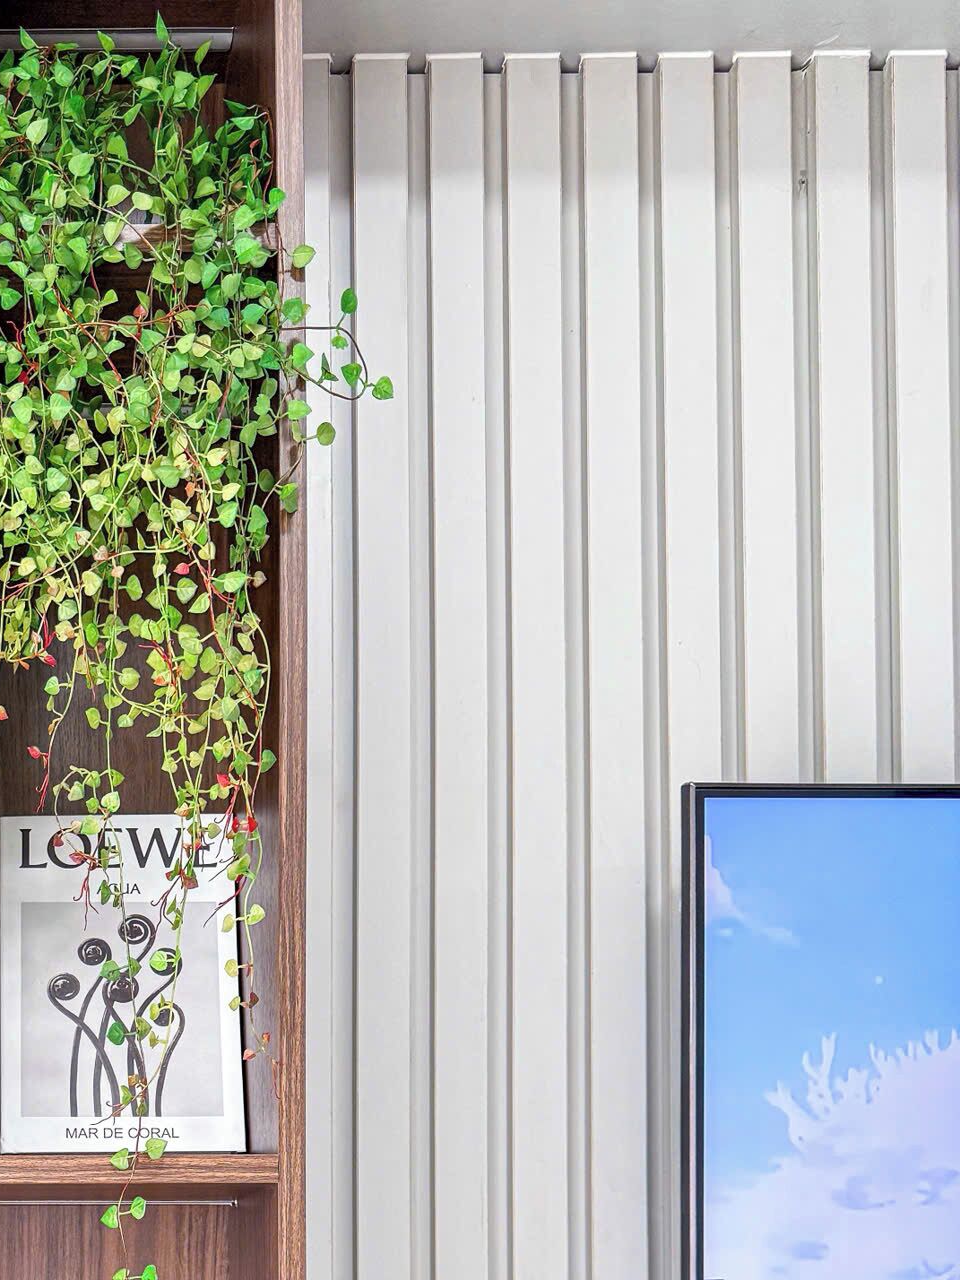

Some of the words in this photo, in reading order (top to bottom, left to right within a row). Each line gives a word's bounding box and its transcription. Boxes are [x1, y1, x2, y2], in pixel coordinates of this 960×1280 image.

[19, 828, 218, 869] LOEWE
[65, 1127, 99, 1139] MAR
[103, 1127, 123, 1139] DE
[127, 1127, 180, 1139] CORAL
